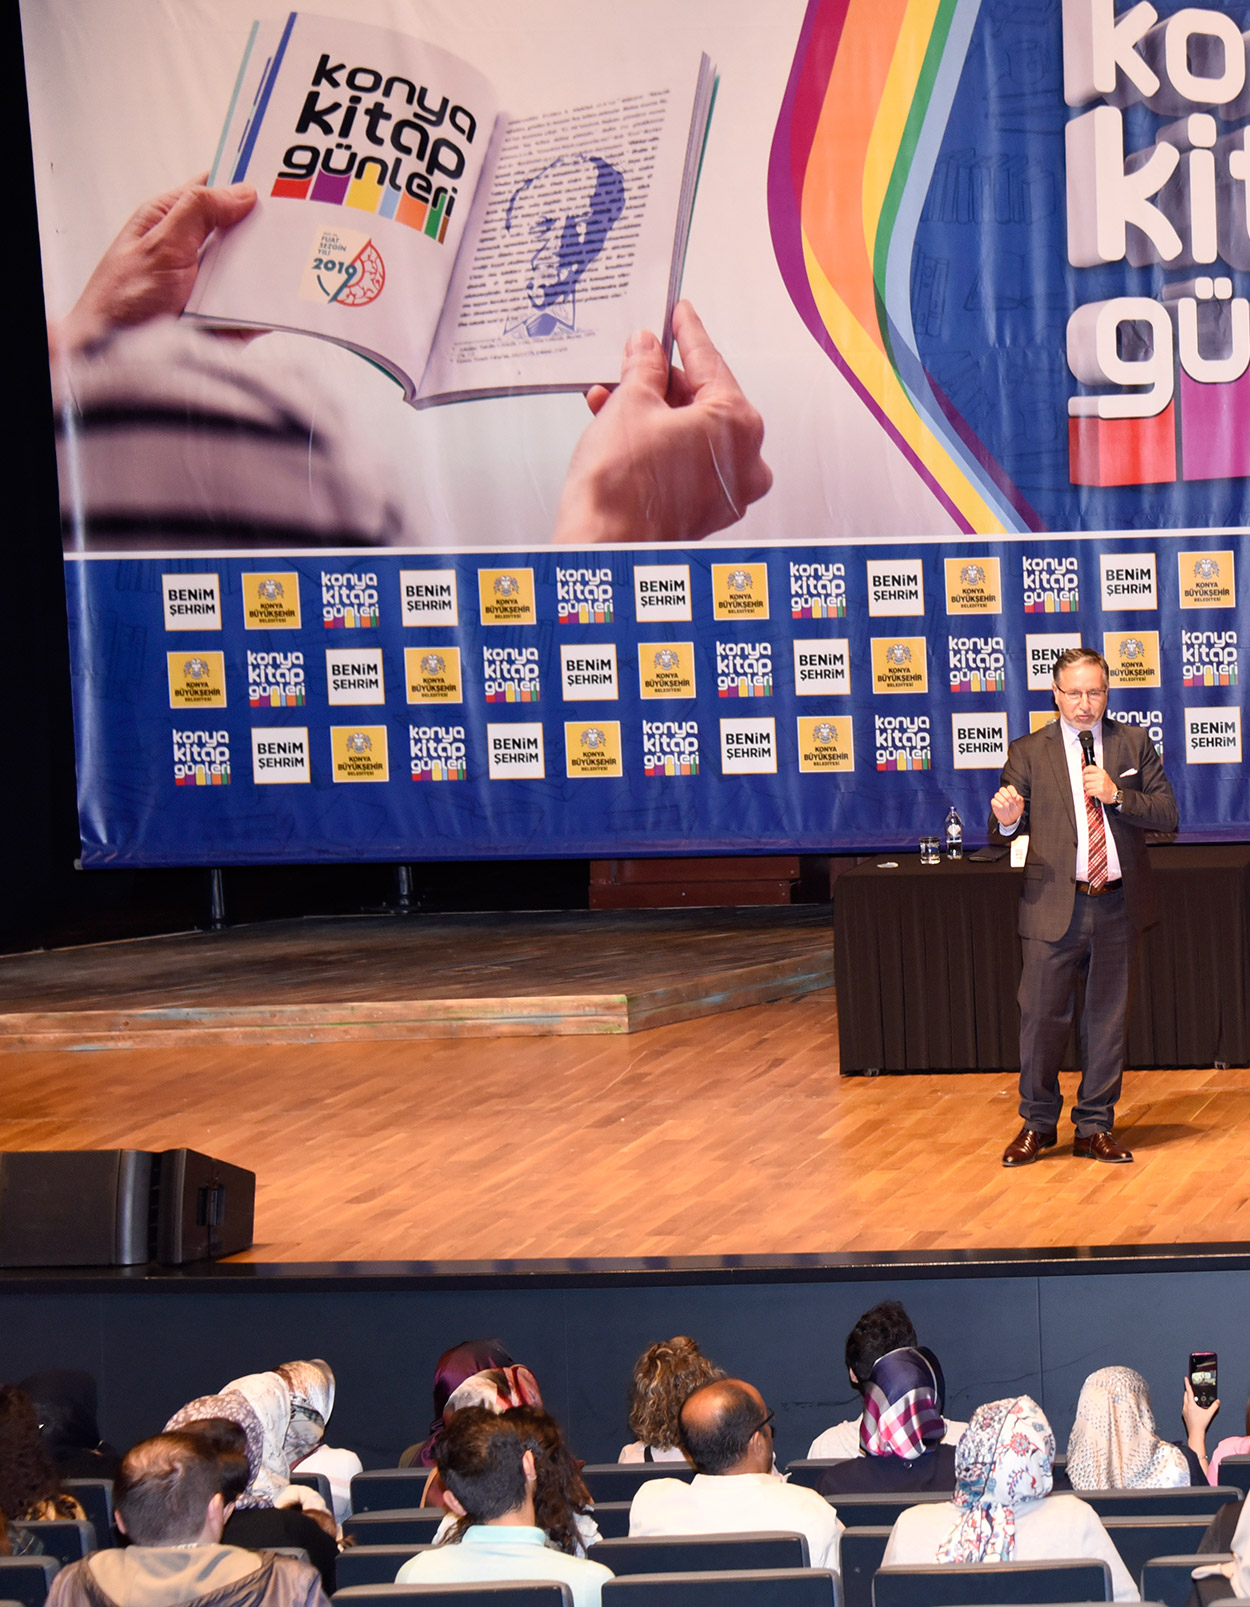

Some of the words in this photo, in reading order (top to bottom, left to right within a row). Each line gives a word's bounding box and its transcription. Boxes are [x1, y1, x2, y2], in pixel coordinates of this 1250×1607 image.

[311, 53, 477, 144] konya
[295, 90, 466, 180] kitap
[277, 142, 458, 218] günleri
[312, 257, 357, 279] 2019
[322, 572, 376, 590] konya
[790, 562, 845, 581] konya
[323, 586, 377, 606] kitap
[790, 577, 846, 597] kitap
[324, 603, 378, 621] günleri
[791, 594, 846, 612] günleri
[948, 636, 1003, 654] konya
[484, 646, 538, 665] konya
[949, 650, 1004, 670] kitap
[484, 661, 539, 681] kitap
[950, 668, 1004, 685] günleri
[485, 678, 540, 696] günleri
[172, 730, 228, 748] konya
[642, 720, 698, 739] konya
[174, 744, 229, 764] kitap
[643, 735, 699, 755] kitap
[175, 761, 230, 779] günleri
[644, 752, 700, 770] günleri
